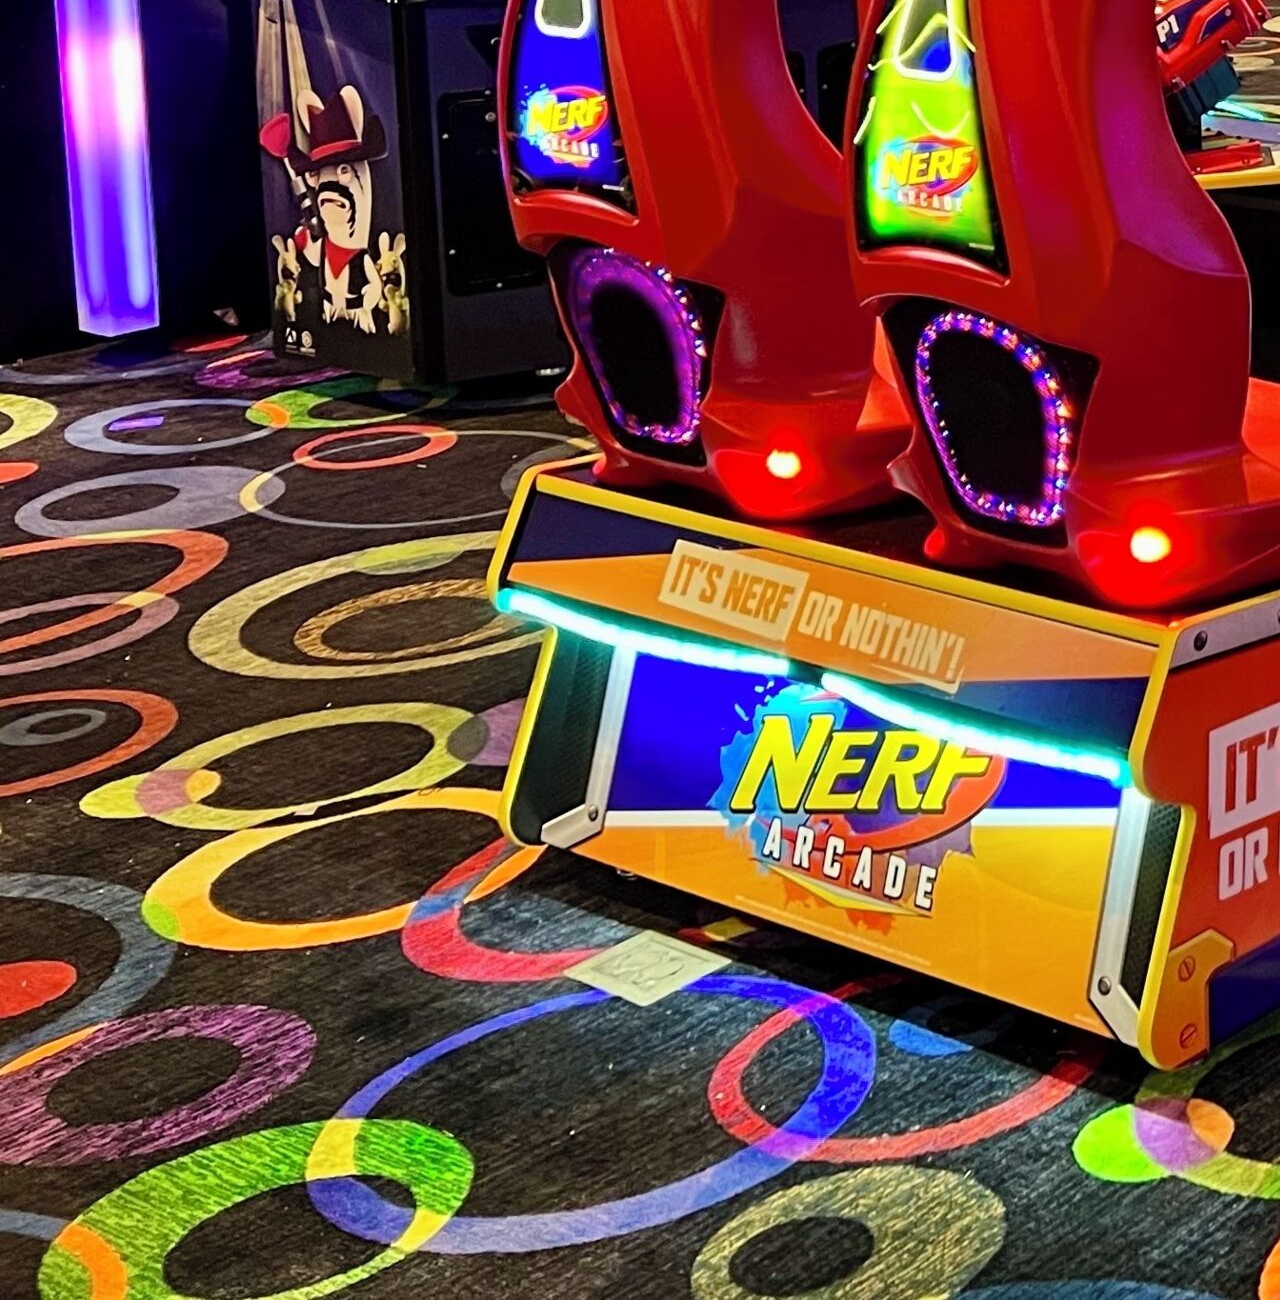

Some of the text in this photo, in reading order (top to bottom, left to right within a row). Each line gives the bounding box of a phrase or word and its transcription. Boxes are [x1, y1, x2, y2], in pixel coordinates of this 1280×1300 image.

[1156, 15, 1180, 43] P1
[527, 95, 606, 135] NERF
[881, 146, 974, 189] NERF
[897, 189, 964, 212] ARCADE
[670, 554, 966, 679] IT'S NERF OR NOTHIN'!
[730, 714, 990, 813] NERF
[762, 817, 937, 910] ARCADE
[1218, 826, 1269, 901] OR
